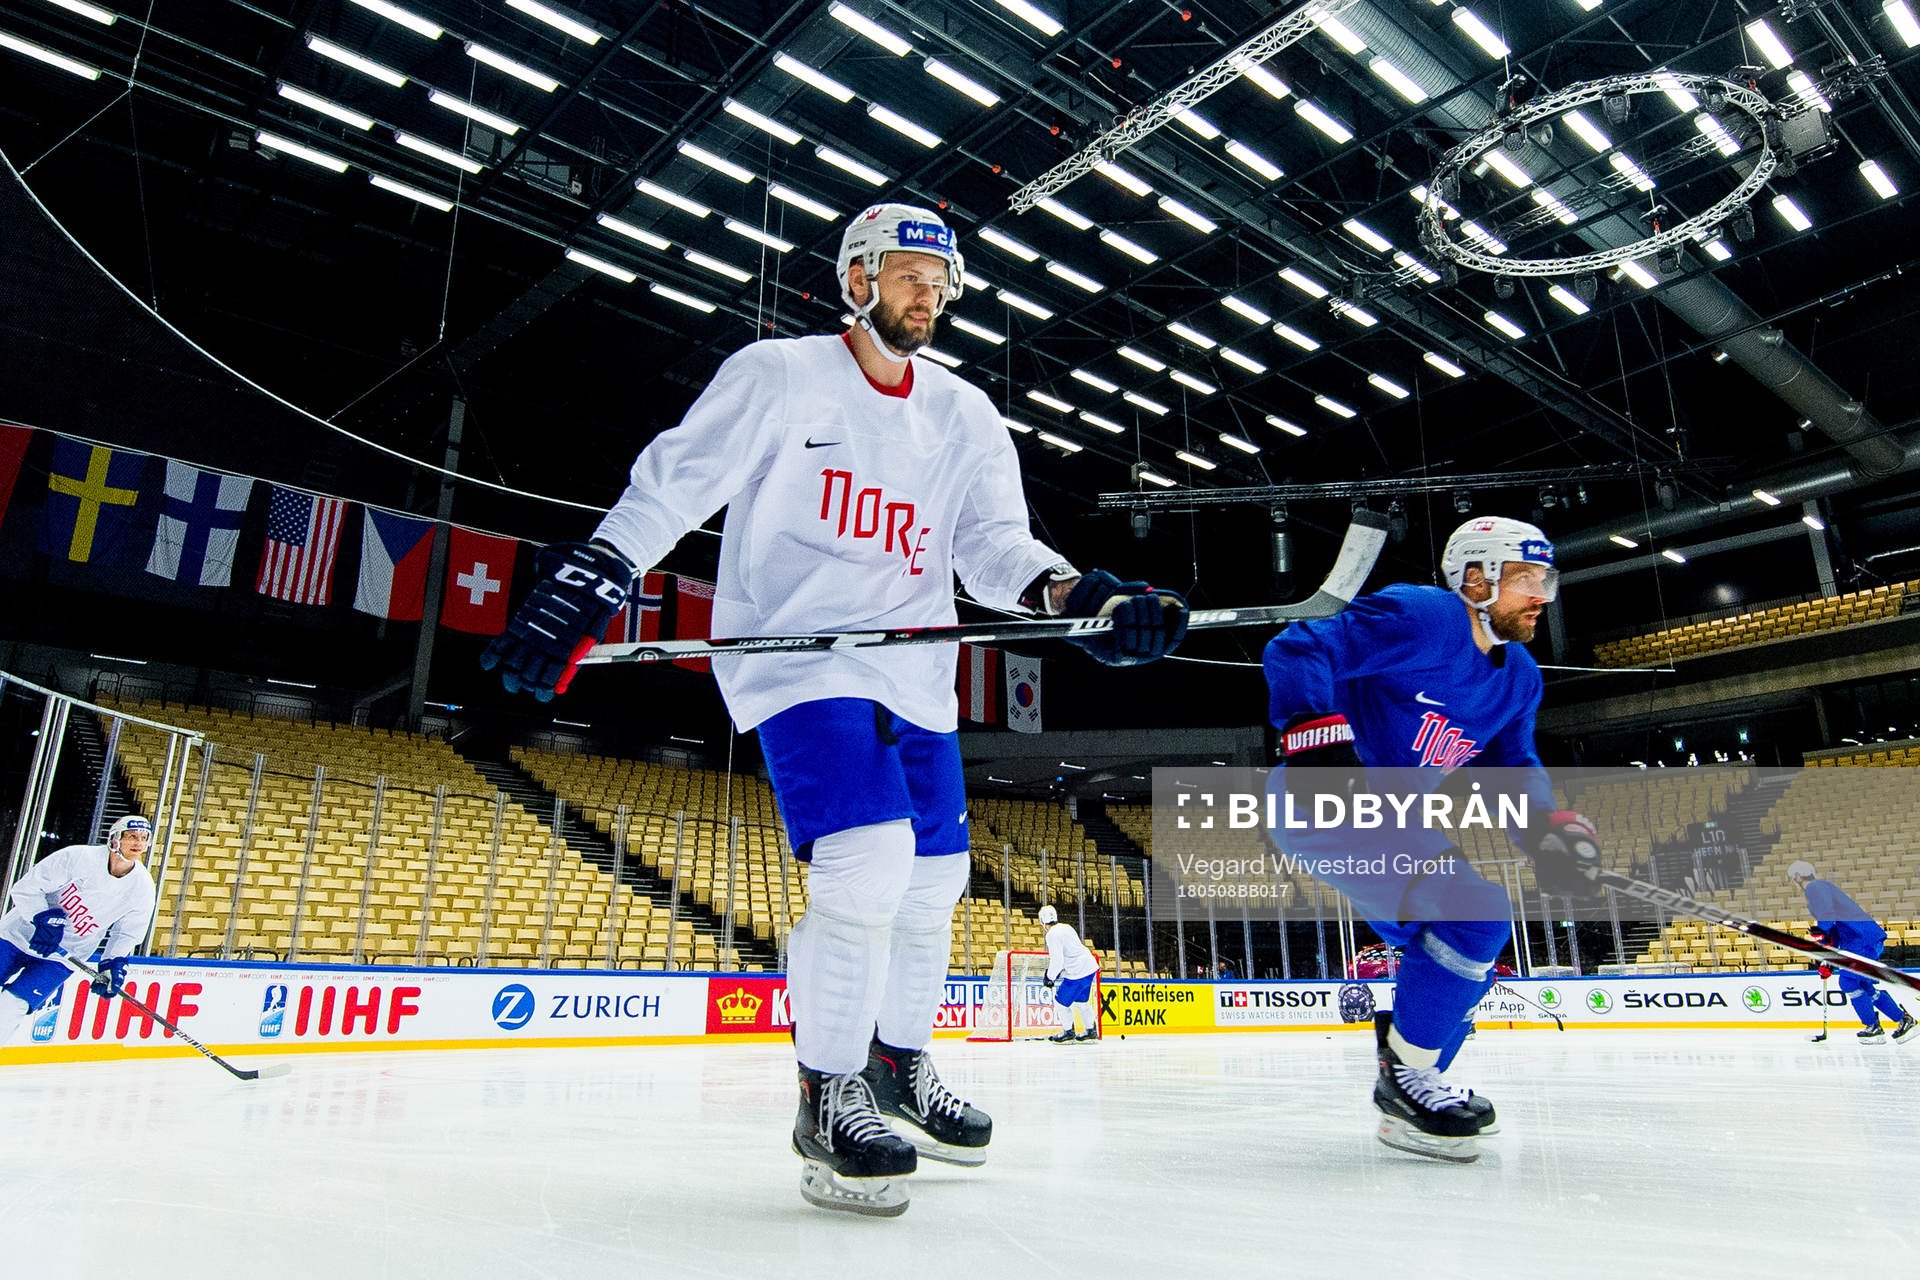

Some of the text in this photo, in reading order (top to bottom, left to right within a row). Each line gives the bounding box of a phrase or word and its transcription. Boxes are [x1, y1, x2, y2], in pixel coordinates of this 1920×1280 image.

[554, 562, 626, 605] CC
[1122, 984, 1194, 1003] Raiffeisen
[1250, 991, 1331, 1007] TISSOT
[1624, 990, 1728, 1008] ŠKODA
[1782, 987, 1848, 1007] ŠKO
[68, 979, 203, 1040] IIHF
[295, 985, 421, 1036] IIHF
[550, 995, 661, 1018] ZURICH
[1028, 1006, 1063, 1026] MOL
[1221, 1011, 1246, 1020] SWISS
[1249, 1011, 1286, 1020] WATCHES
[1288, 1011, 1313, 1019] SINCE
[1500, 1001, 1526, 1013] App
[934, 1006, 965, 1027] OLY
[1124, 1009, 1166, 1026] BANK
[33, 1025, 54, 1036] IIHF
[260, 1023, 281, 1034] IIHF
